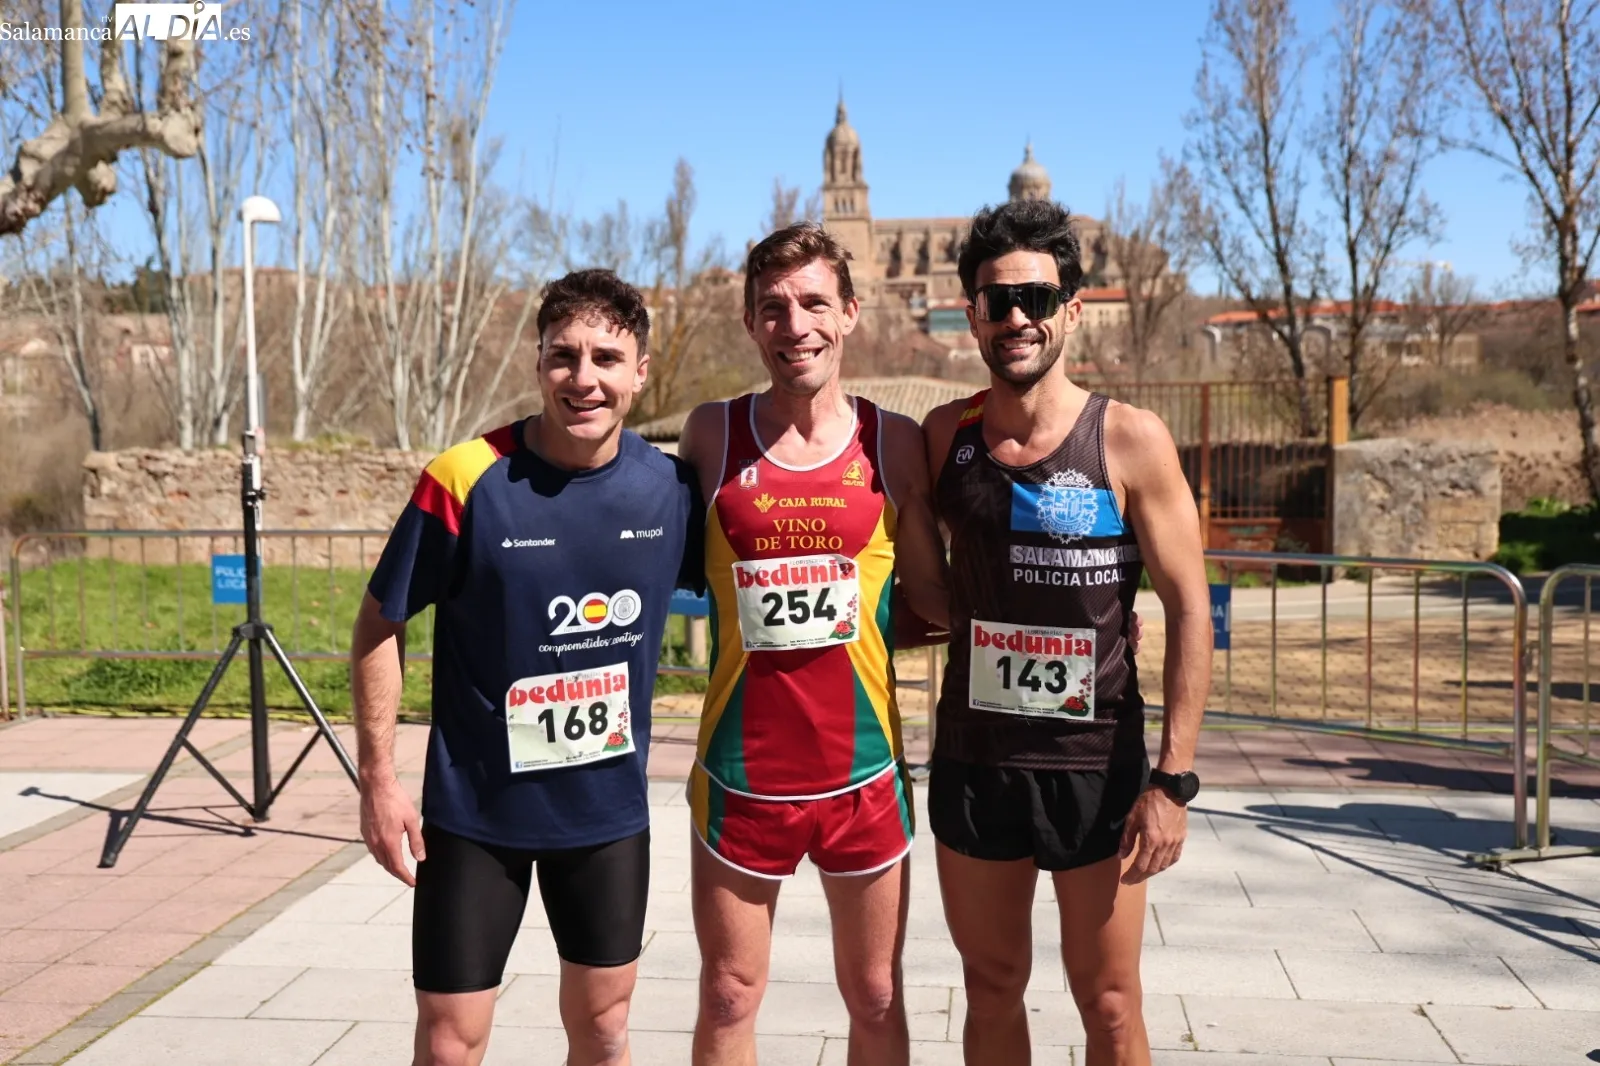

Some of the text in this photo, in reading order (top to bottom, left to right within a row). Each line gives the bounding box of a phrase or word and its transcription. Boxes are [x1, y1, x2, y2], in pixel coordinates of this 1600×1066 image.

[778, 497, 847, 508] CAJA RURAL
[636, 527, 663, 539] mupol
[773, 517, 826, 532] VINO
[513, 538, 556, 548] Santander
[755, 535, 843, 551] DE TORO
[1011, 546, 1125, 567] SALAMANCA
[1013, 568, 1126, 586] POLICIA LOCAL
[548, 589, 642, 636] 200
[761, 587, 838, 627] 254
[538, 635, 609, 657] comprometidos
[974, 625, 1093, 657] bedunia
[996, 656, 1068, 695] 143
[537, 701, 609, 744] 168
